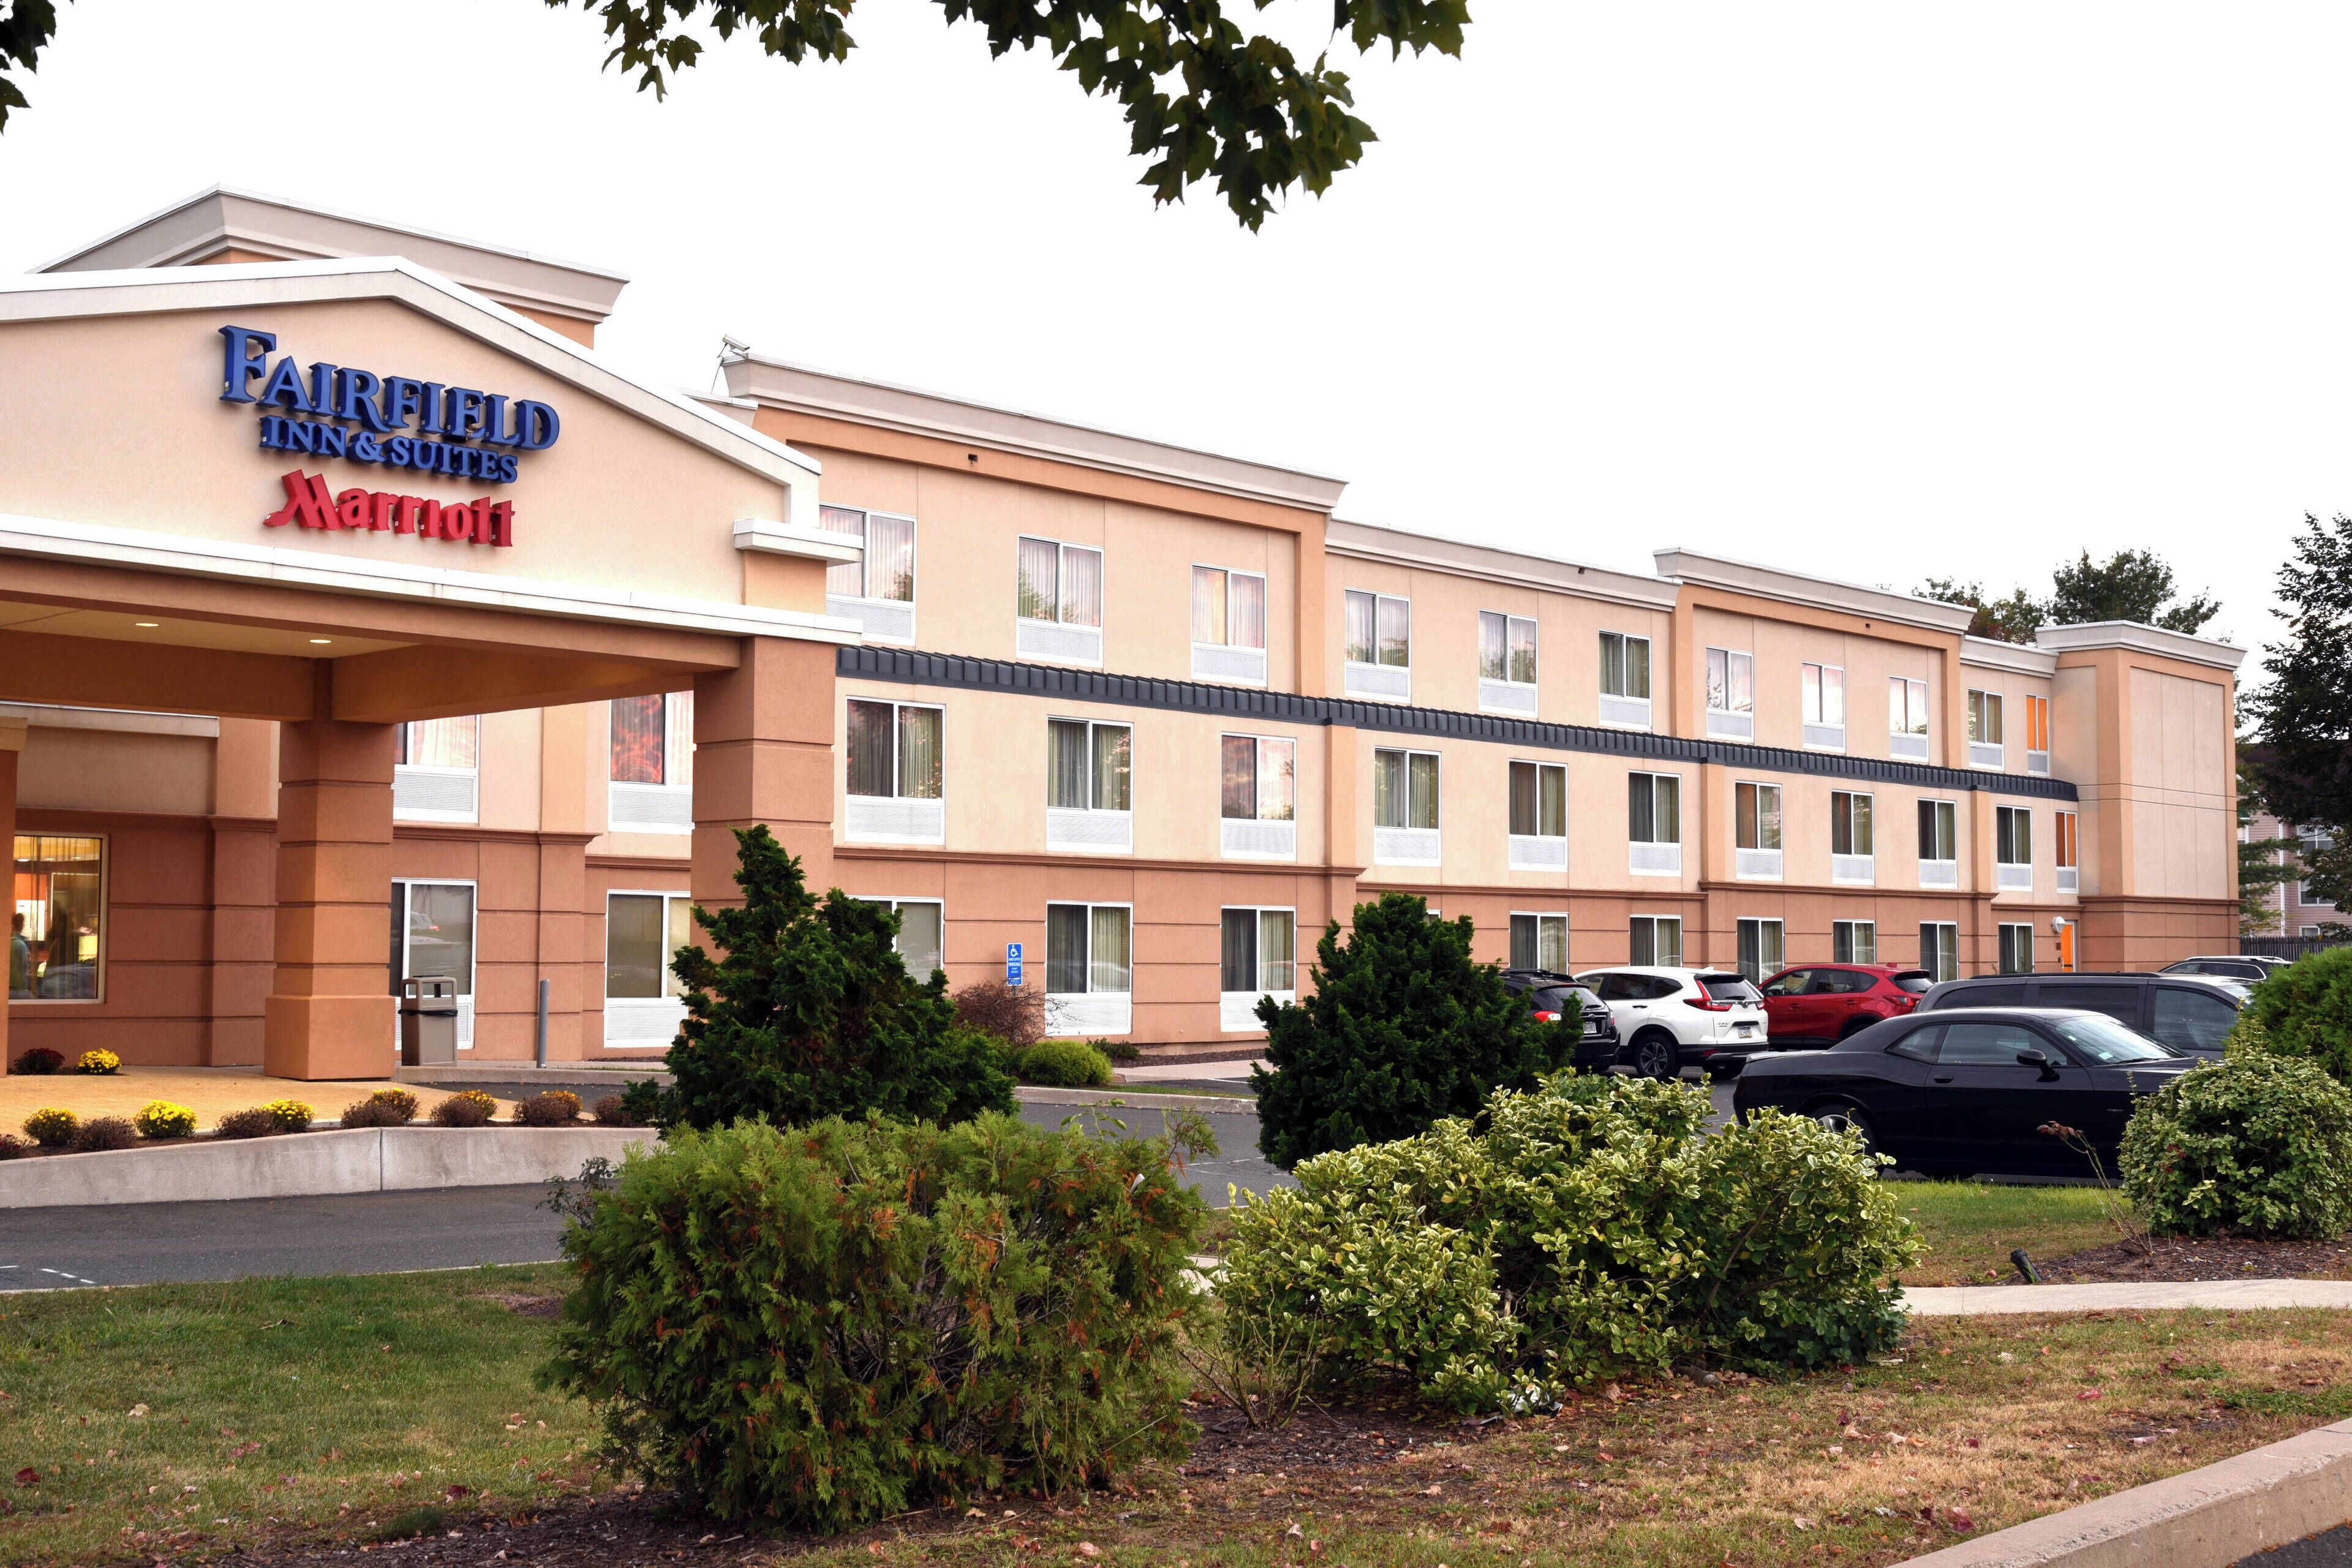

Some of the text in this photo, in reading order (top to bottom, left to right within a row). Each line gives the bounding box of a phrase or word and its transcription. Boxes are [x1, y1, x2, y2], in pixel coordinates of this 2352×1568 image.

[219, 325, 560, 450] FAIRFIELD
[260, 415, 349, 458] INN
[383, 435, 518, 483] SUITES
[263, 469, 515, 547] Marriott
